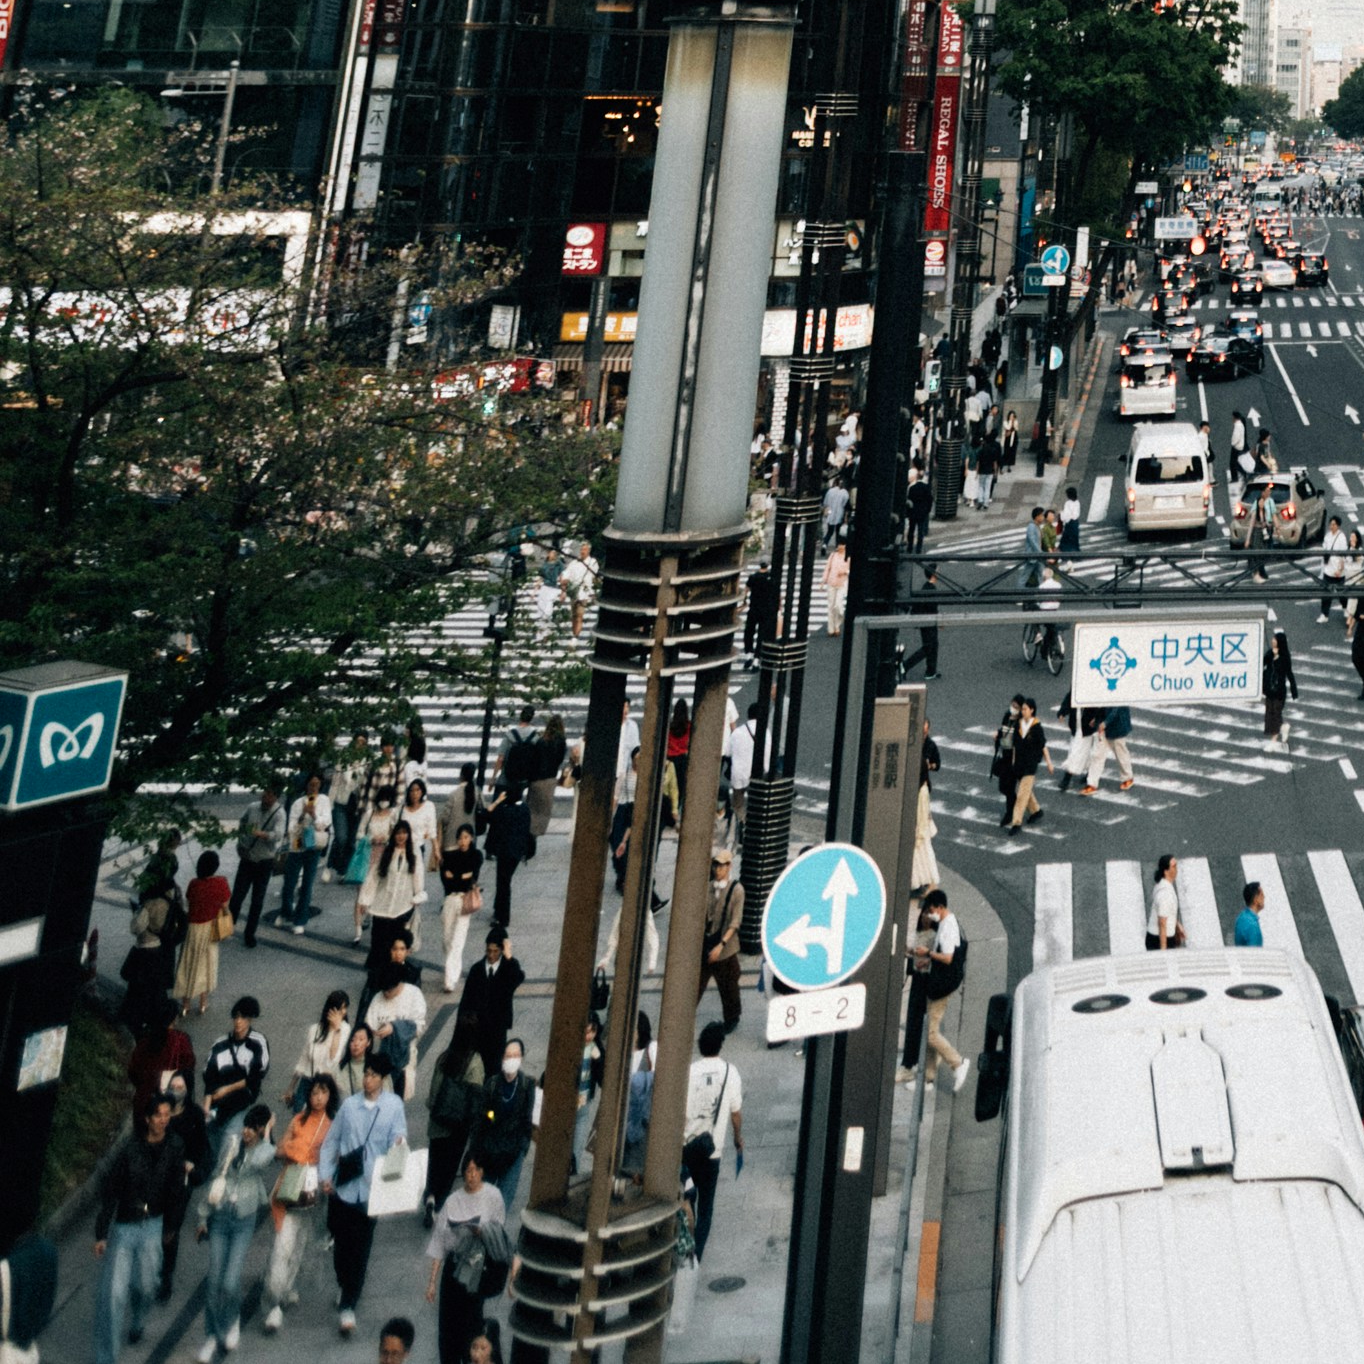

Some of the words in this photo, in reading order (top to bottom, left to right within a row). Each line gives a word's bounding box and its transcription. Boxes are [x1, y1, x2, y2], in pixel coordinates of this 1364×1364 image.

[942, 14, 951, 53] レストラン
[937, 97, 952, 150] REGAL
[932, 155, 948, 209] SHOES
[1151, 632, 1249, 668] 中央区
[1151, 673, 1194, 692] Chuo
[1203, 671, 1248, 690] Ward
